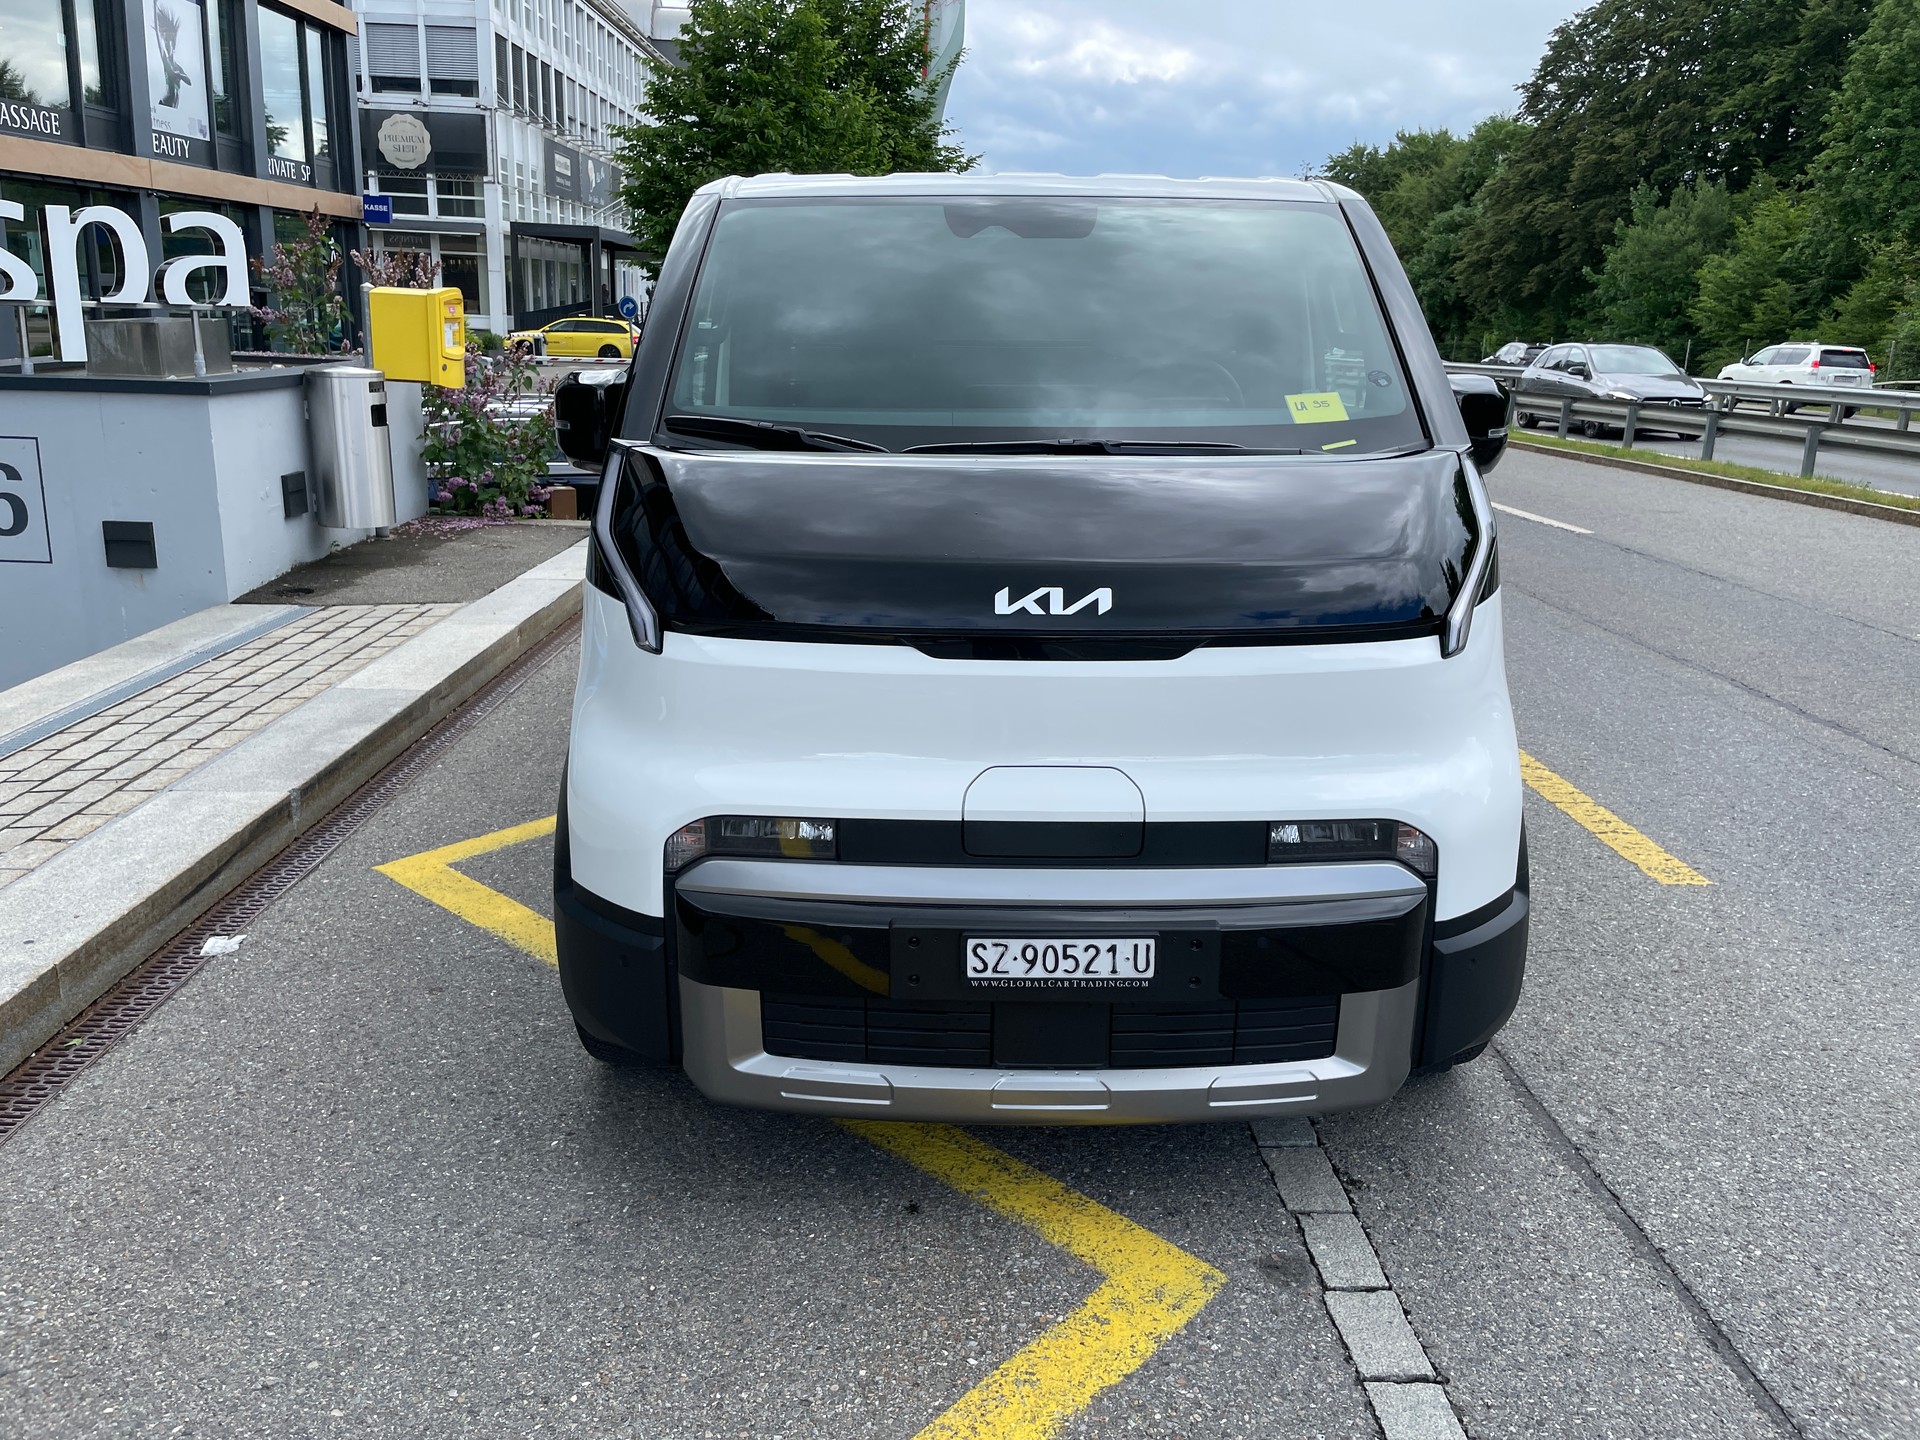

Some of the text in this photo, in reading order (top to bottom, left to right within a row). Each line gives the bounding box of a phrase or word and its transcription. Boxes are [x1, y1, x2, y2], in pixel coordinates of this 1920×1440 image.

[383, 133, 425, 144] PREMIUM
[152, 132, 190, 159] EAUTY
[392, 144, 418, 153] SHOP
[364, 203, 388, 212] KASSE
[994, 586, 1113, 616] KIA
